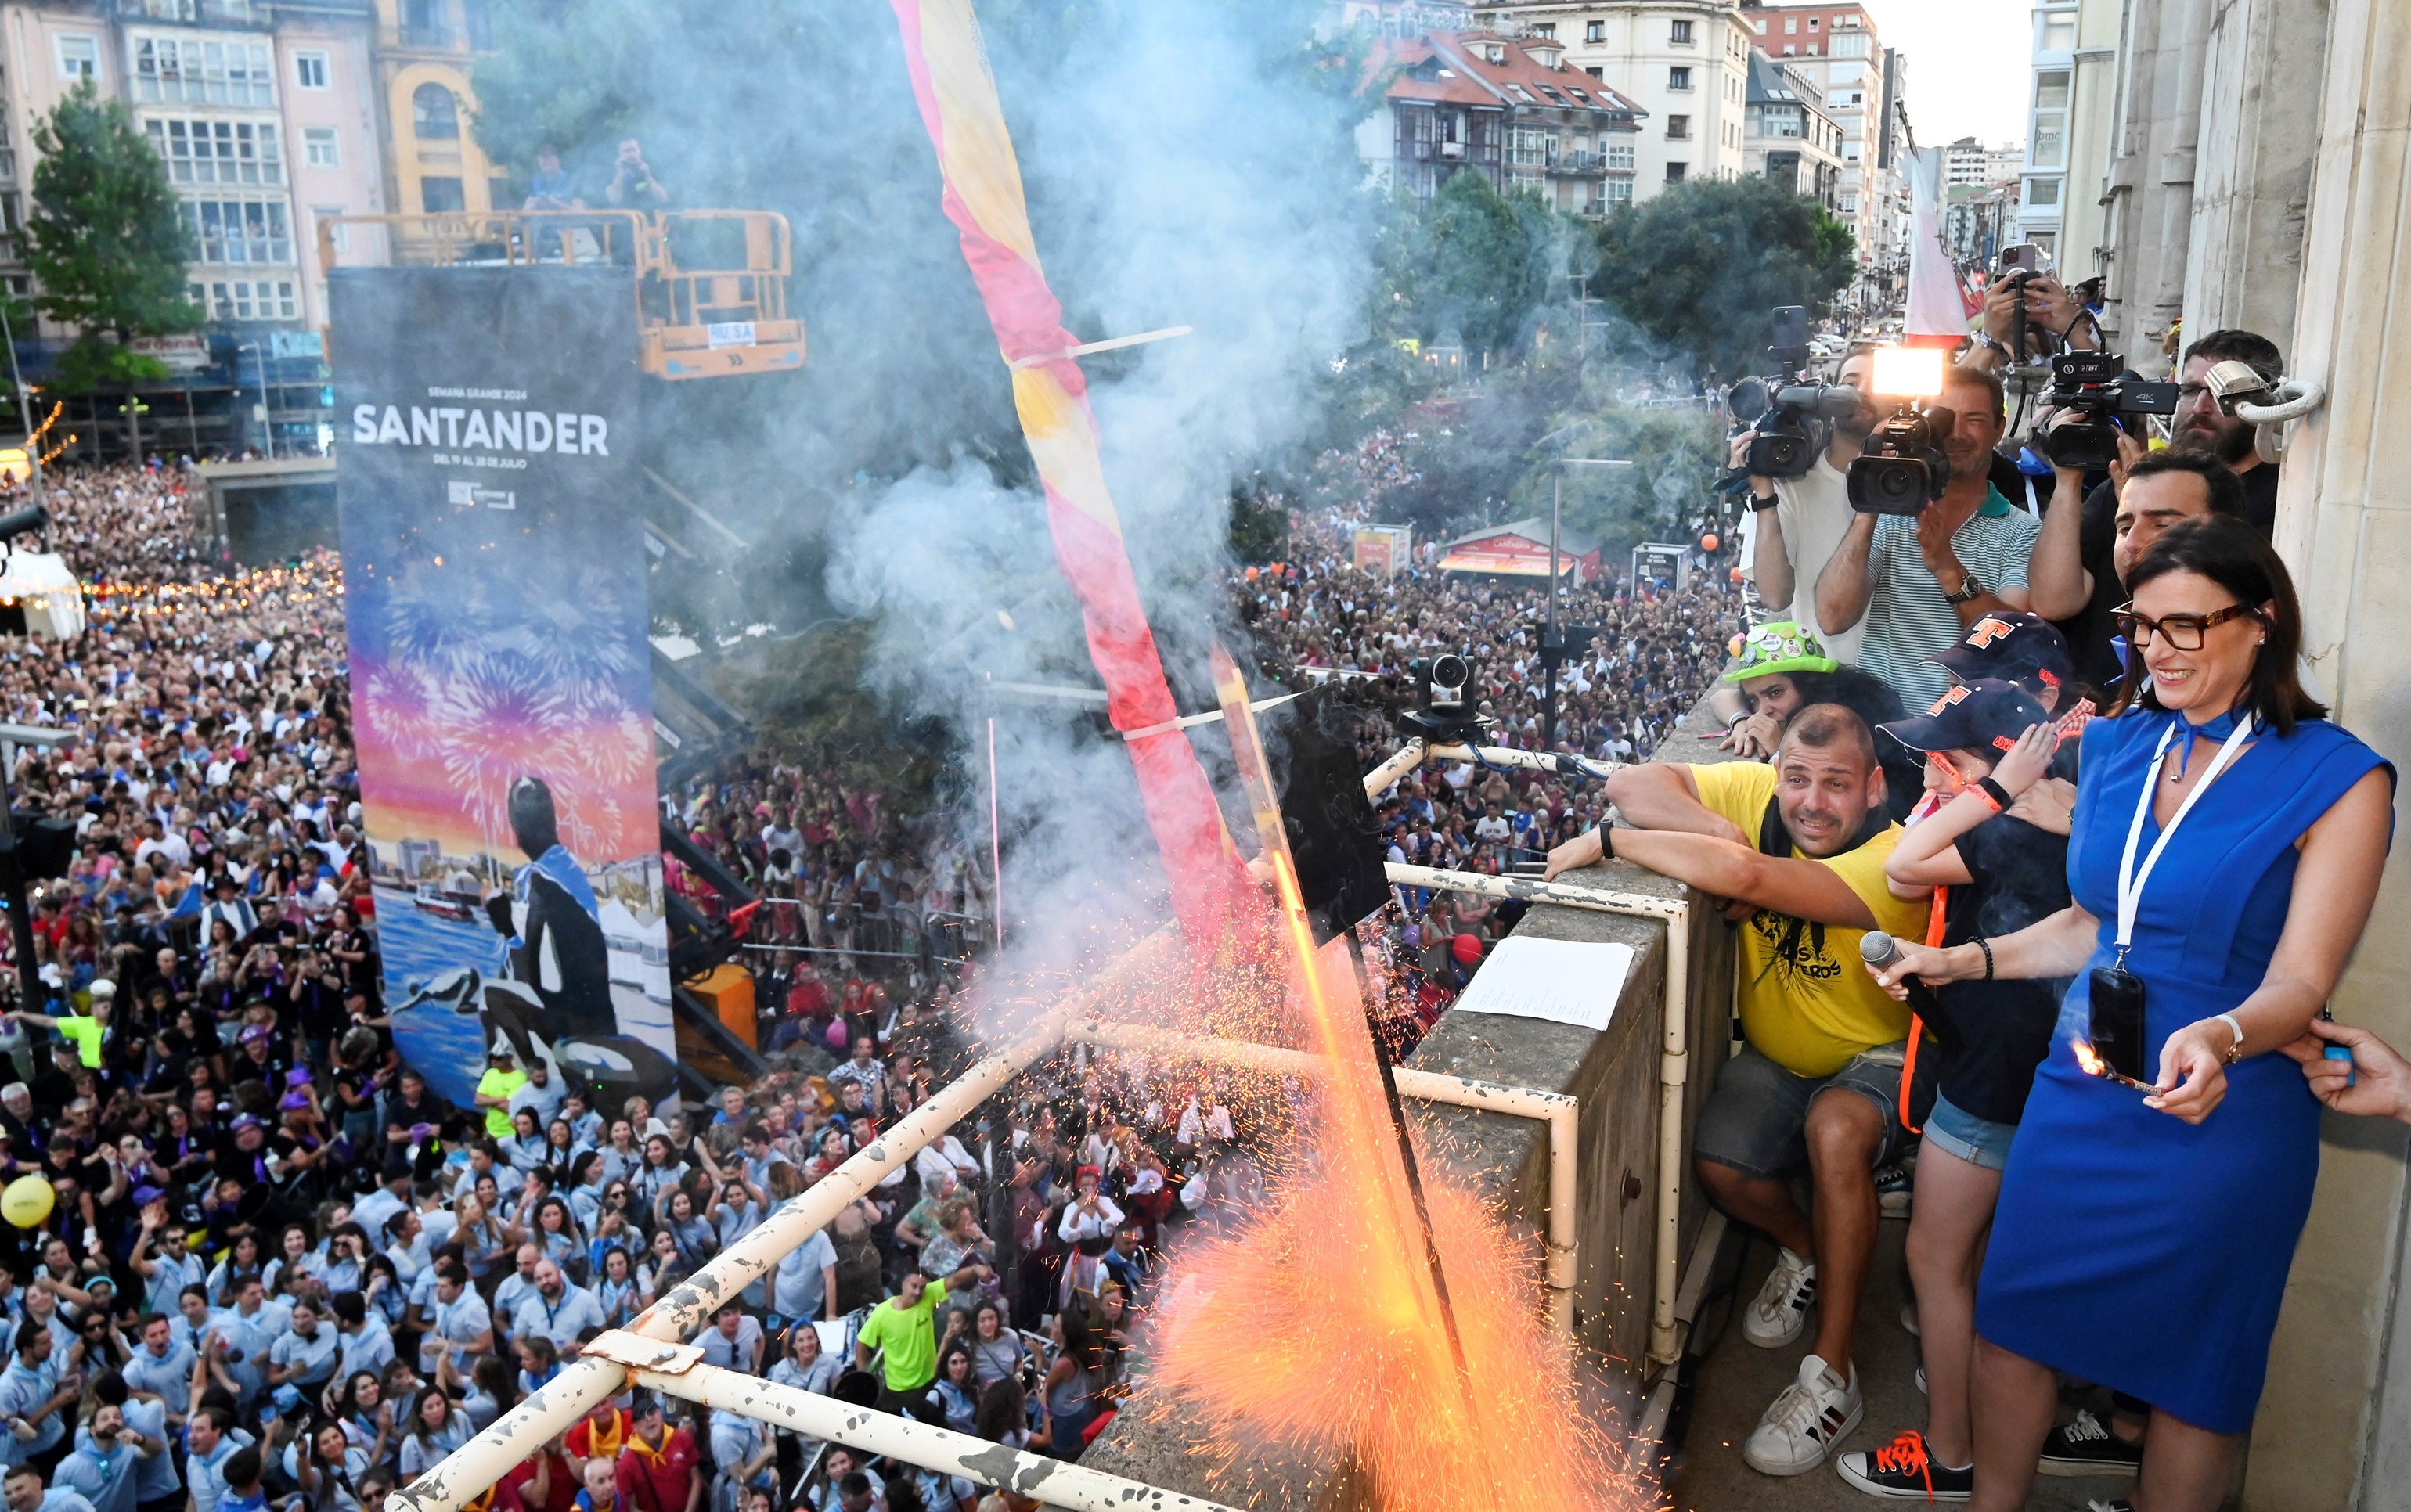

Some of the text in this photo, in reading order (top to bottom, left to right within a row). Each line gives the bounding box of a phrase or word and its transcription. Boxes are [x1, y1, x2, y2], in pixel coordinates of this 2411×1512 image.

[2038, 130, 2060, 141] bmc
[428, 387, 528, 400] SEMANA GRANDE 2024
[353, 403, 609, 456] SANTANDER
[433, 453, 451, 466] DEL
[462, 455, 474, 467] AL
[487, 456, 499, 469] DE
[499, 458, 528, 470] JULIO
[1966, 618, 2016, 650] T
